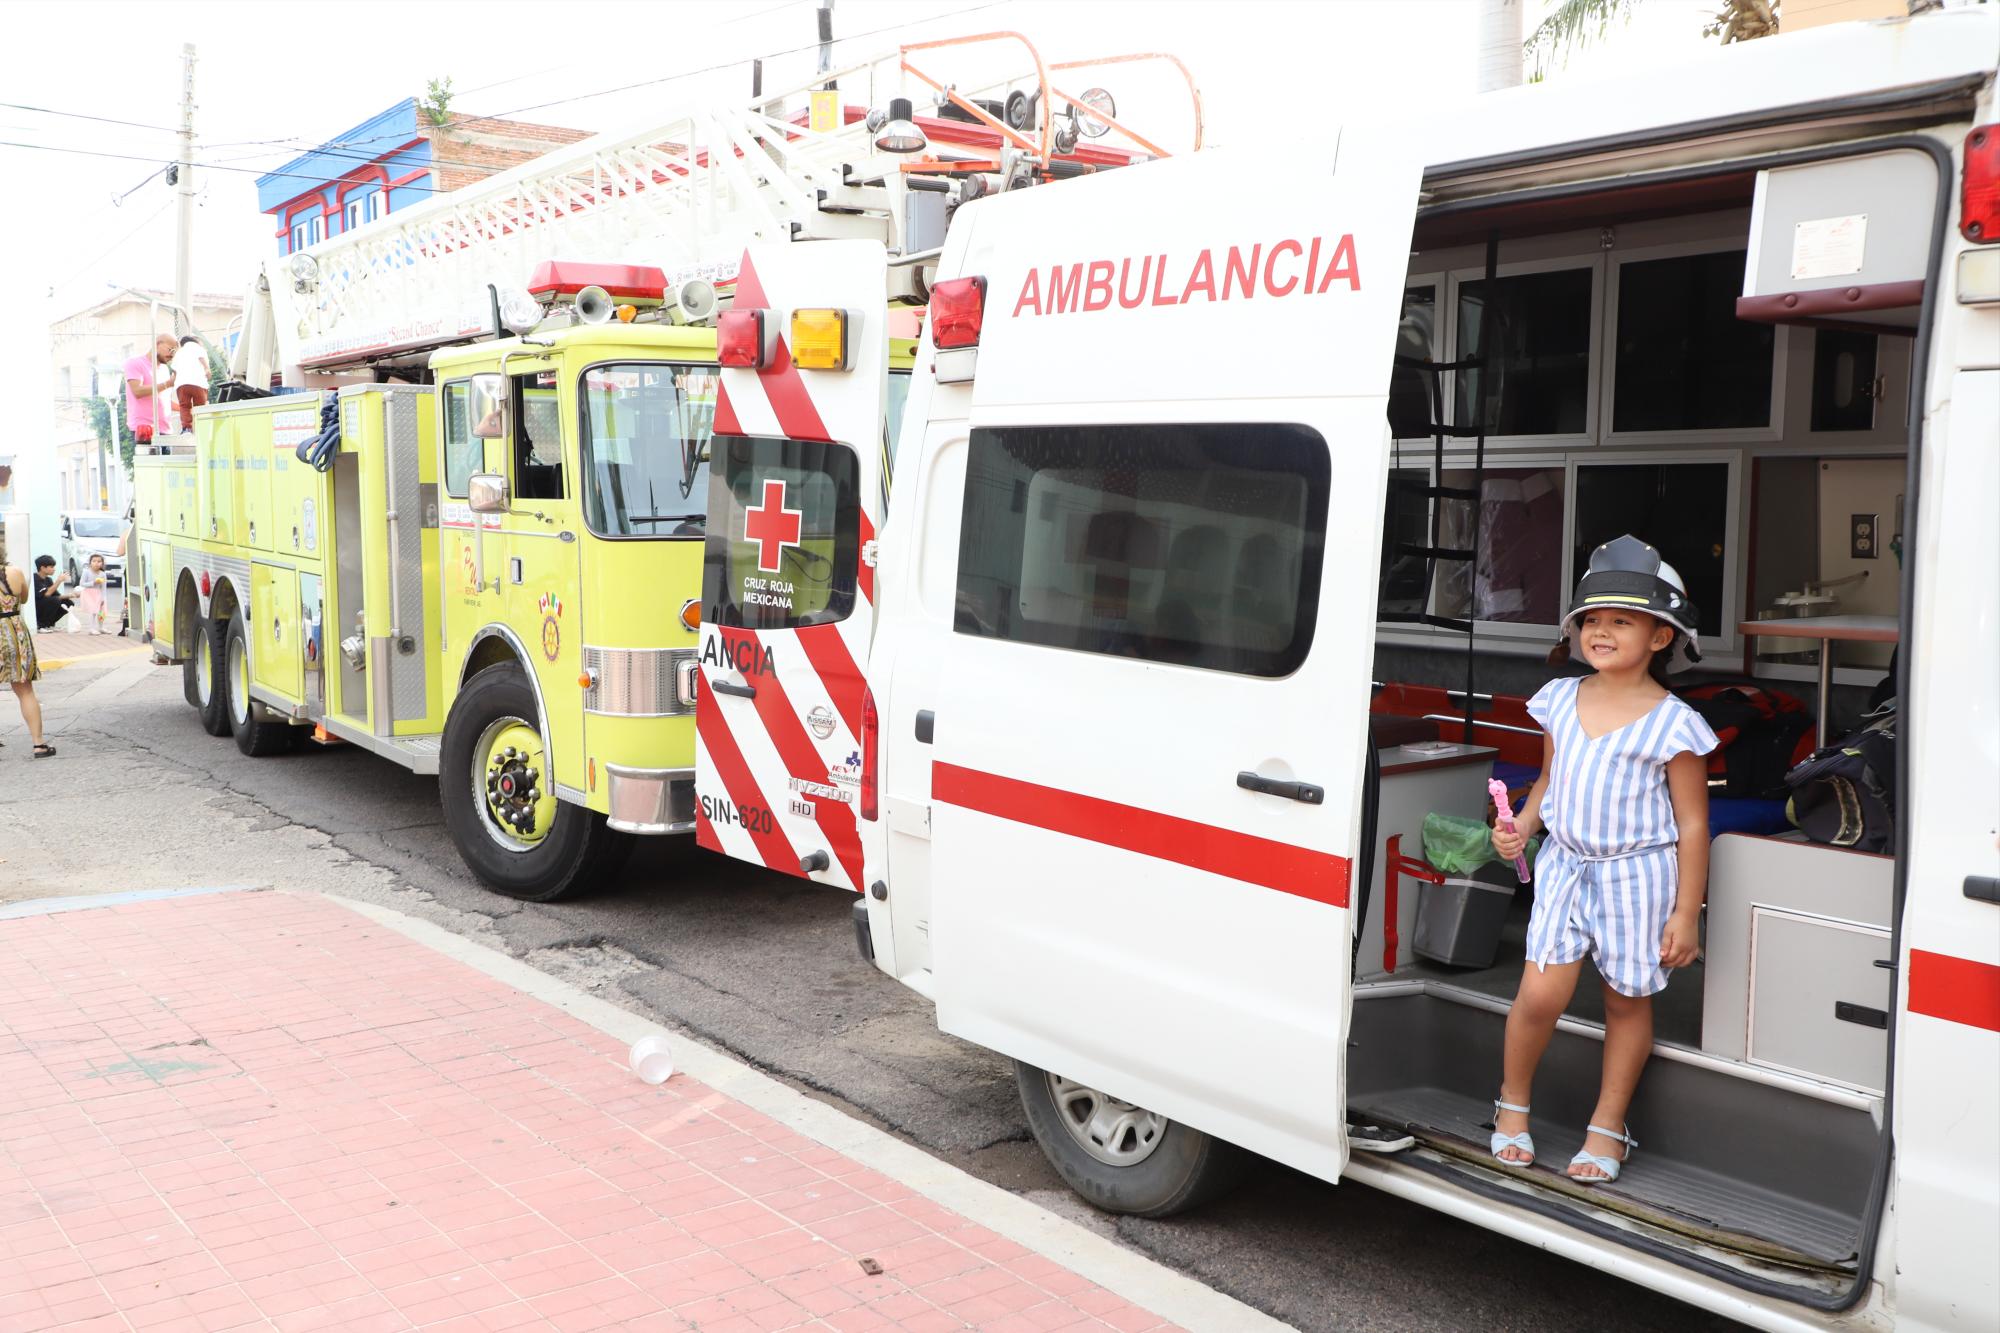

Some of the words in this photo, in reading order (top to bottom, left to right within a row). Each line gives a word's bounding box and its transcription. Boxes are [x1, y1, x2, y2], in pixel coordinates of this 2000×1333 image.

[1012, 233, 1361, 318] AMBULANCIA
[744, 576, 767, 590] CRUZ
[770, 580, 794, 594] ROJA
[743, 591, 793, 609] MEXICANA
[698, 634, 778, 679] ANCIA
[701, 794, 773, 835] SIN-620
[792, 801, 811, 816] HD
